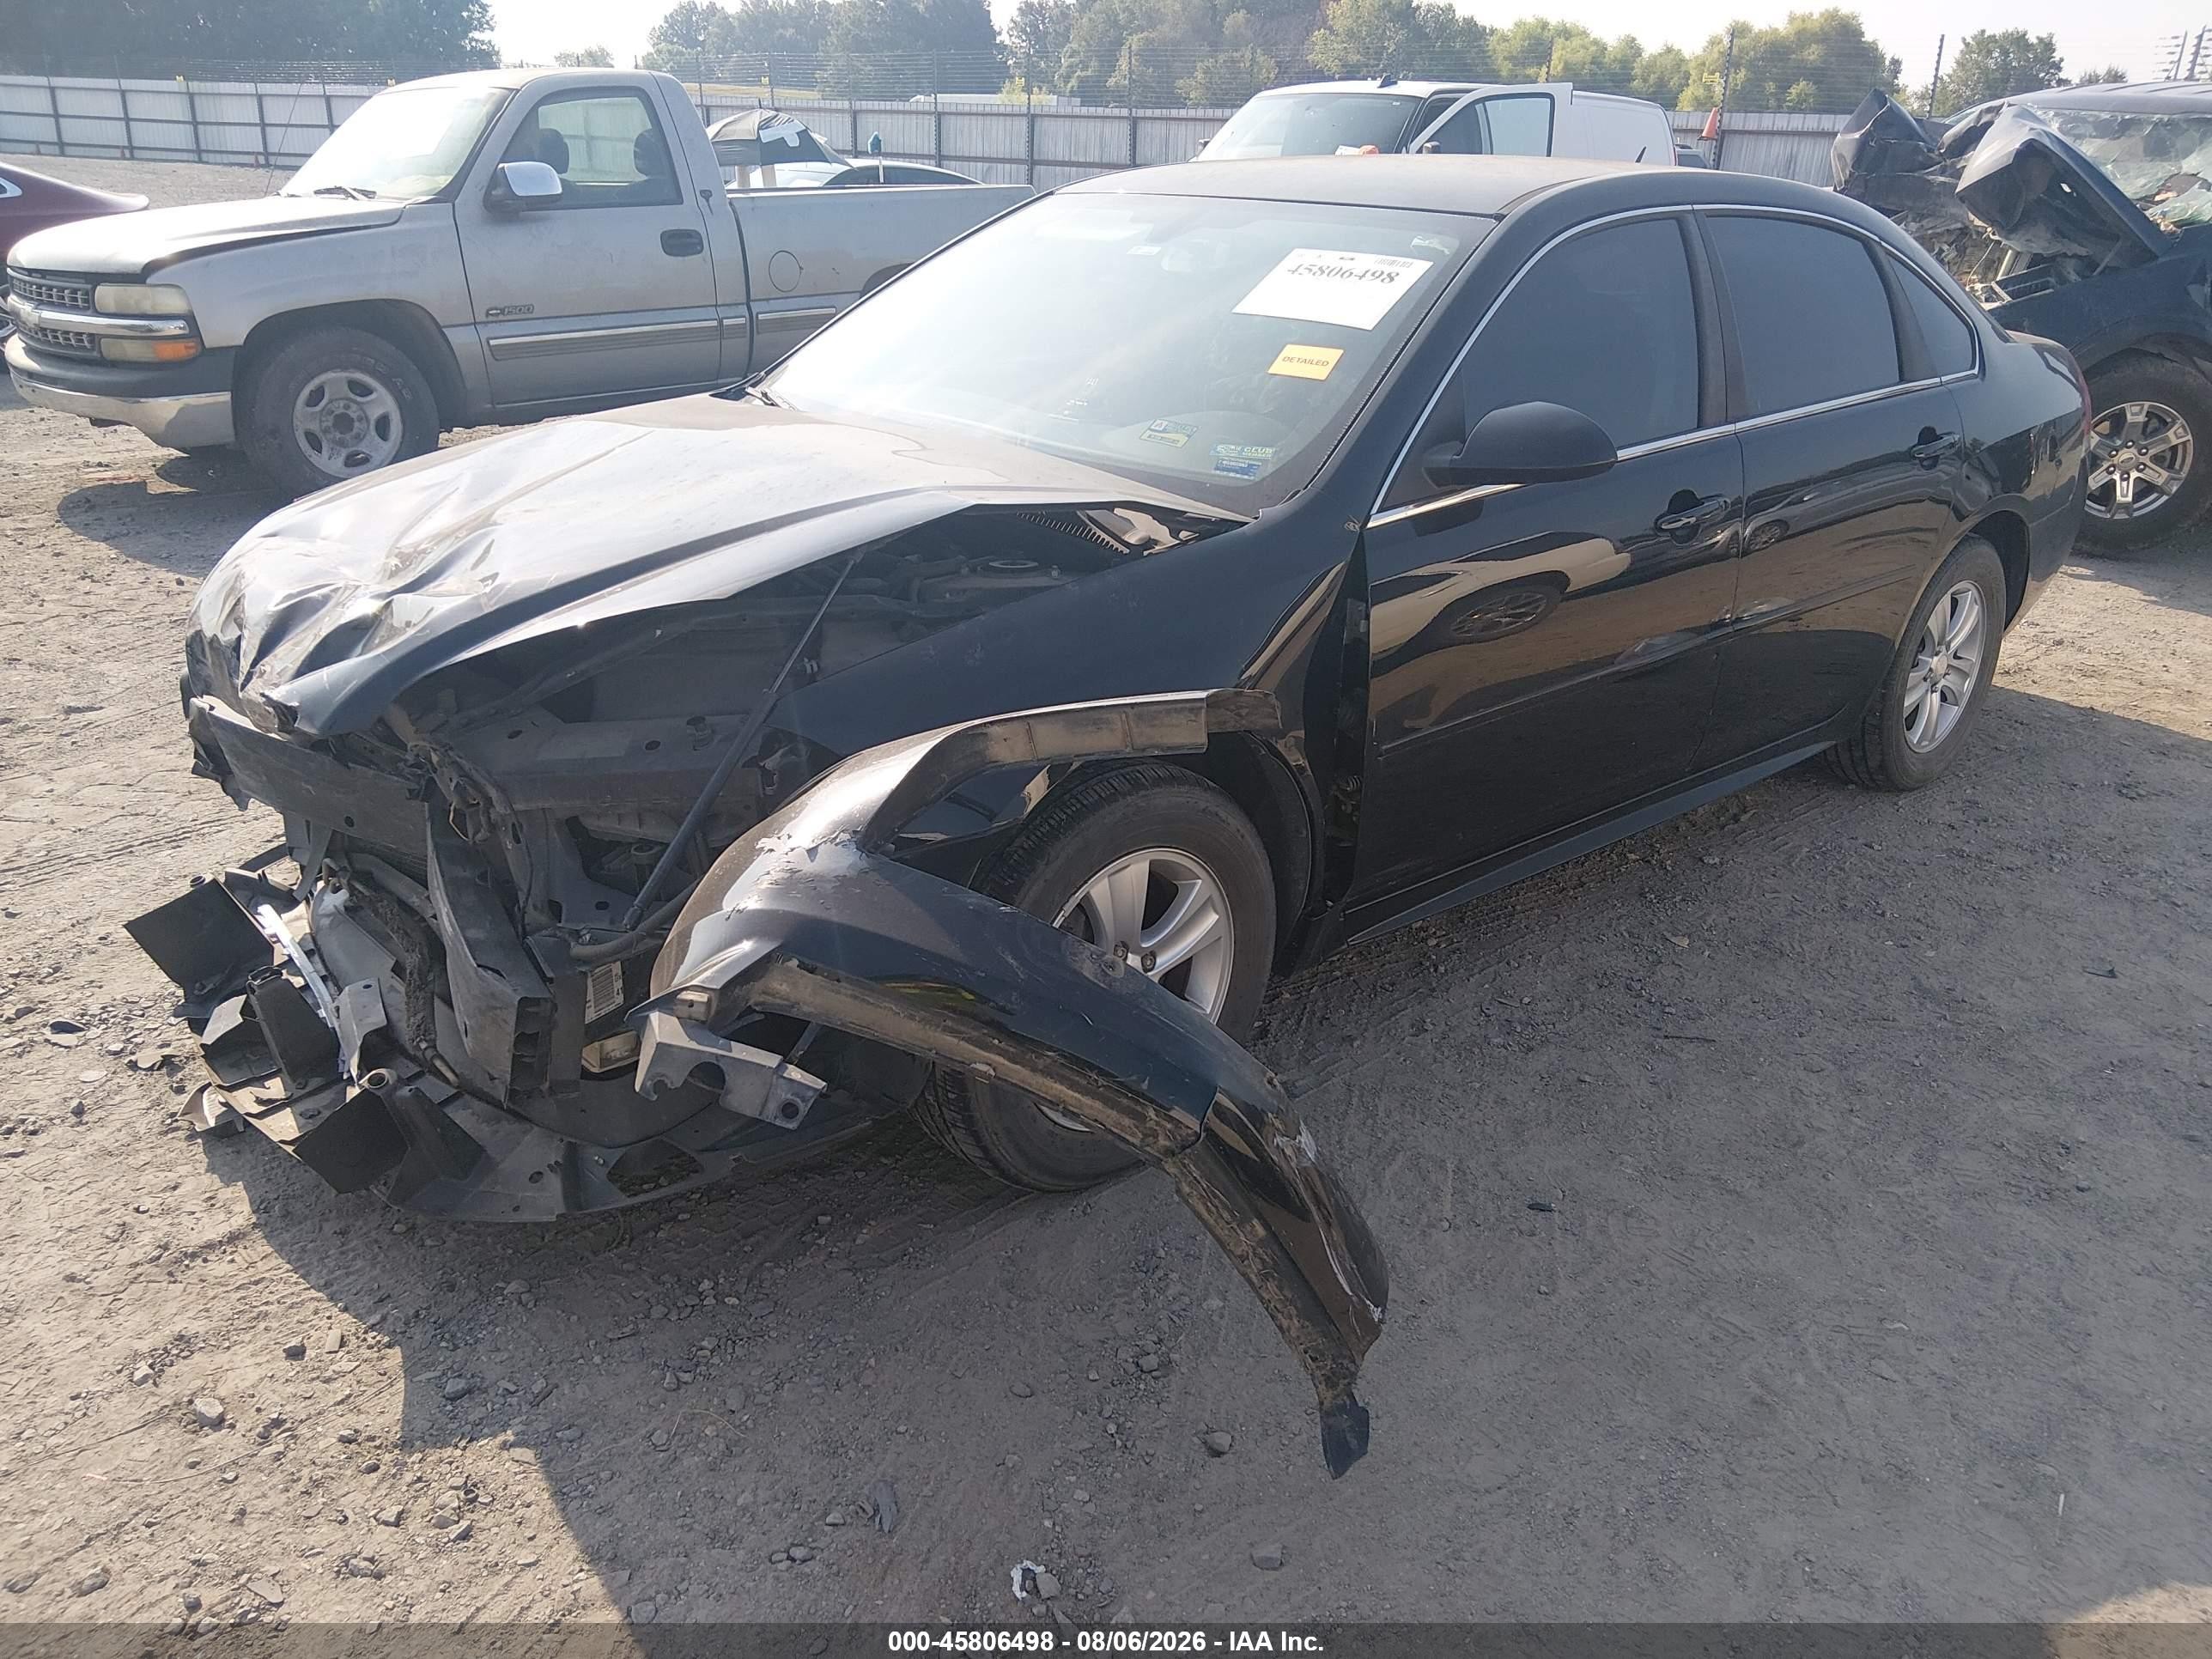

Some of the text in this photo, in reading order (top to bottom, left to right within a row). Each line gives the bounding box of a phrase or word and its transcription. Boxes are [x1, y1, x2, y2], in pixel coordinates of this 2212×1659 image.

[1286, 263, 1401, 284] 45806498
[502, 305, 534, 315] 1500
[1280, 355, 1331, 368] DETAILED
